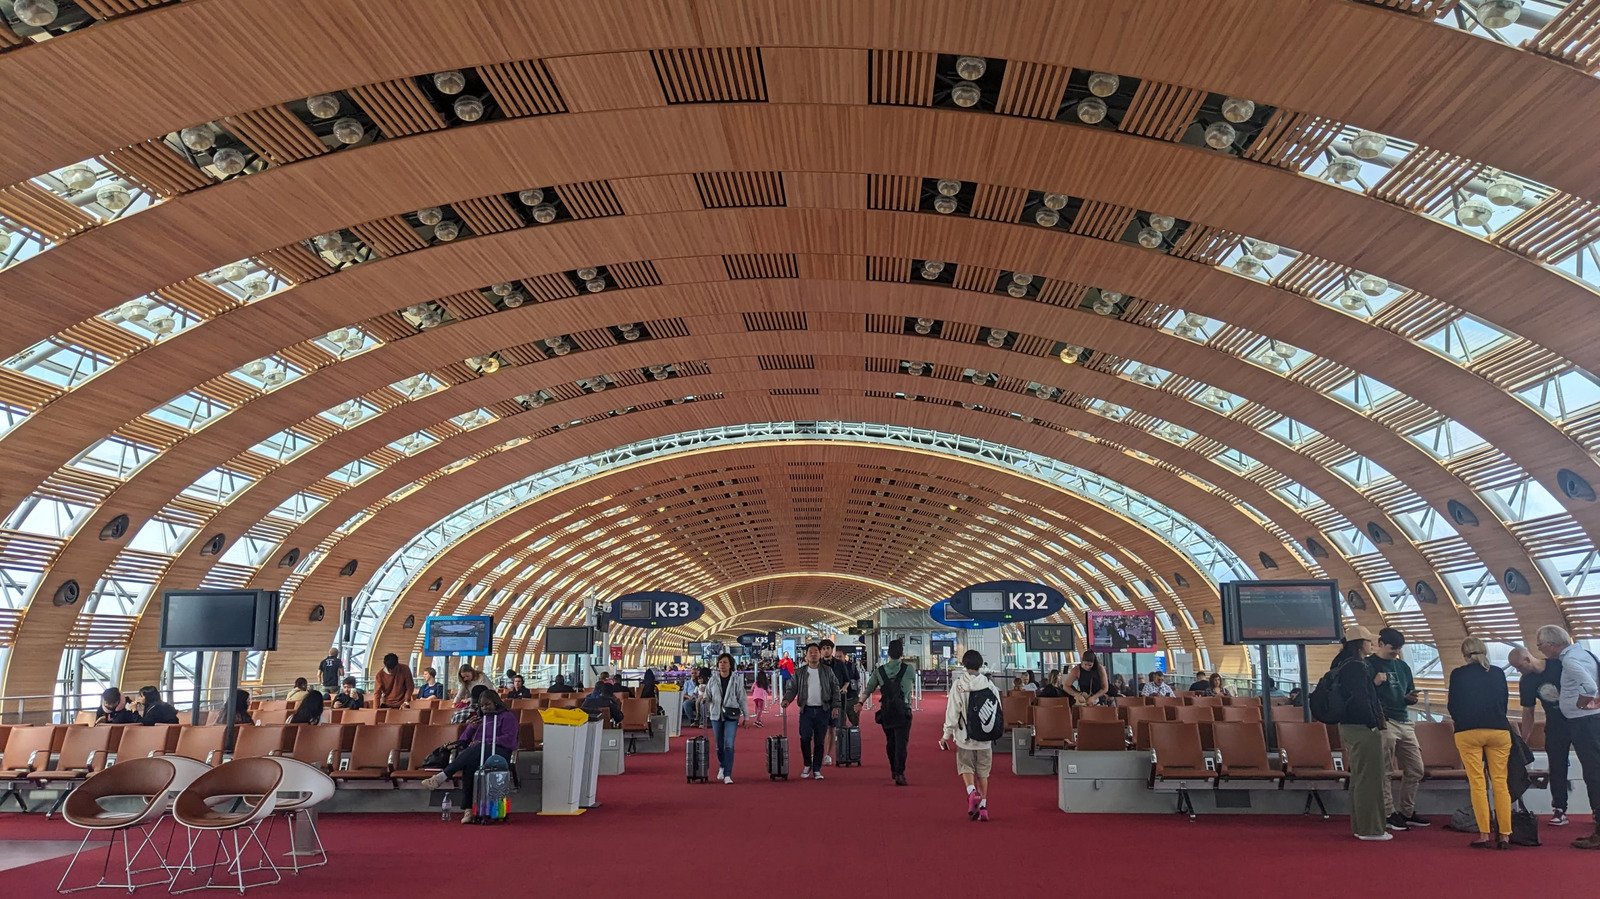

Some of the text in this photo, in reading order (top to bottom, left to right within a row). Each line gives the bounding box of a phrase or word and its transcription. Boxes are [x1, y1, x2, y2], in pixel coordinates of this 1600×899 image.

[655, 602, 689, 618] K33
[1009, 592, 1048, 610] K32
[978, 698, 995, 724] NIKE
